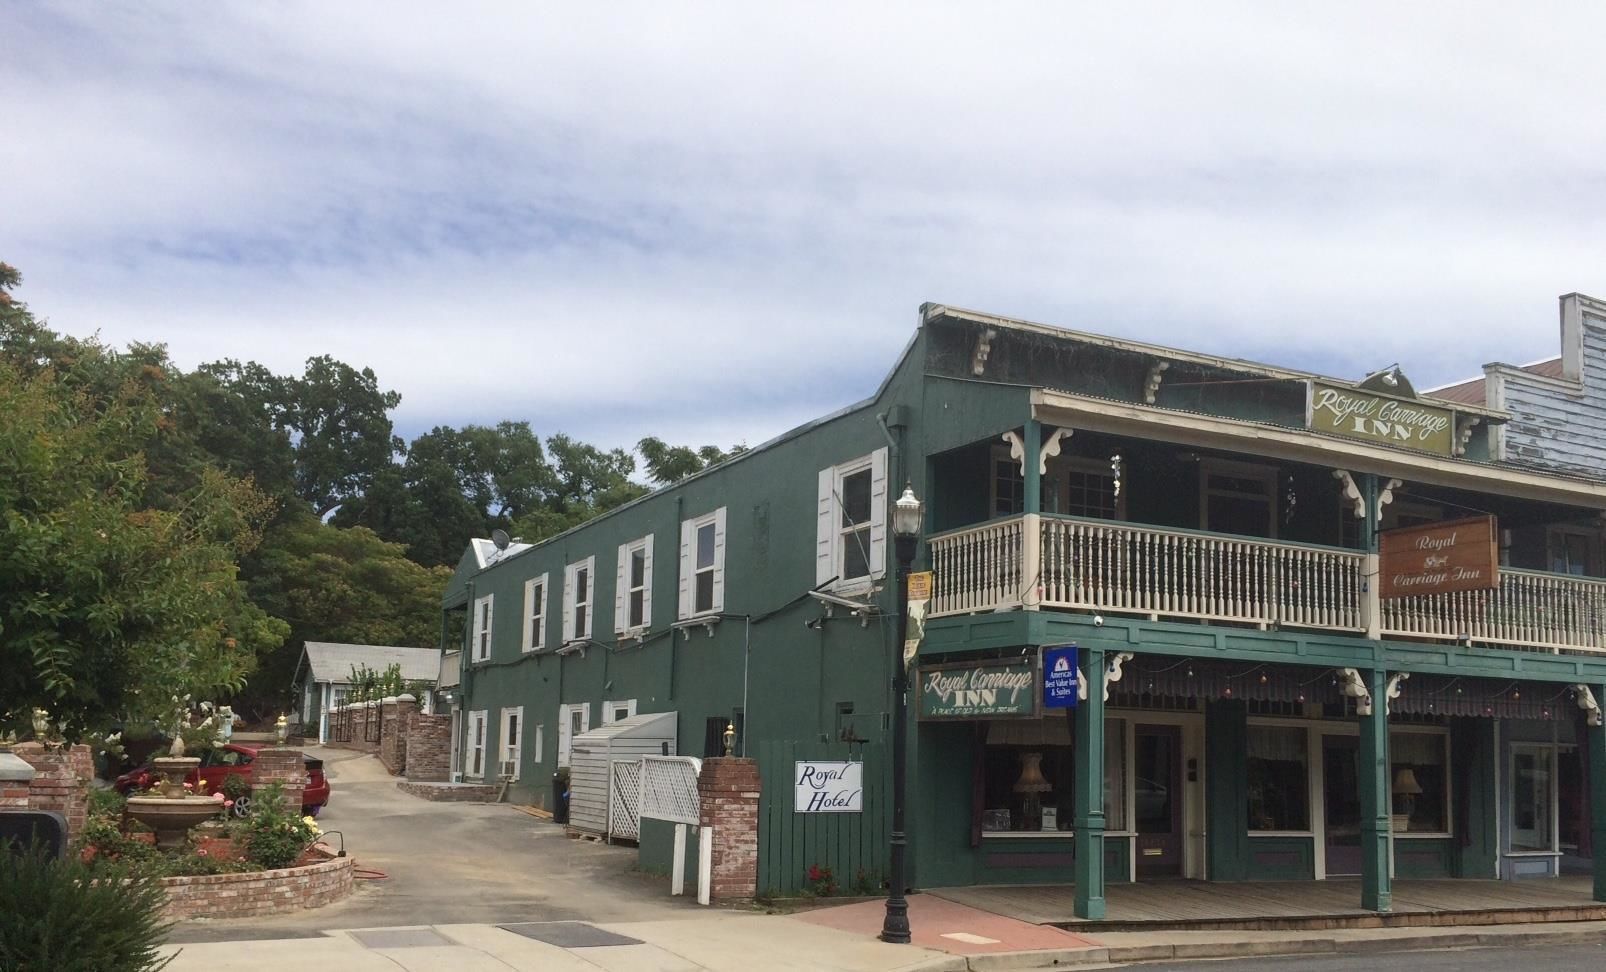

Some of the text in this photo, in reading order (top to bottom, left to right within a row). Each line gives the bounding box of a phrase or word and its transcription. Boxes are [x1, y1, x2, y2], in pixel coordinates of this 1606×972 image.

[1312, 389, 1448, 440] Royal Carriage
[1353, 417, 1413, 440] INN
[1416, 532, 1456, 551] Royal
[1393, 566, 1480, 587] Carriage Inn
[924, 667, 1033, 704] Royal Carriage
[952, 688, 999, 707] INN
[796, 763, 854, 790] Royal
[806, 789, 862, 811] Hotel
